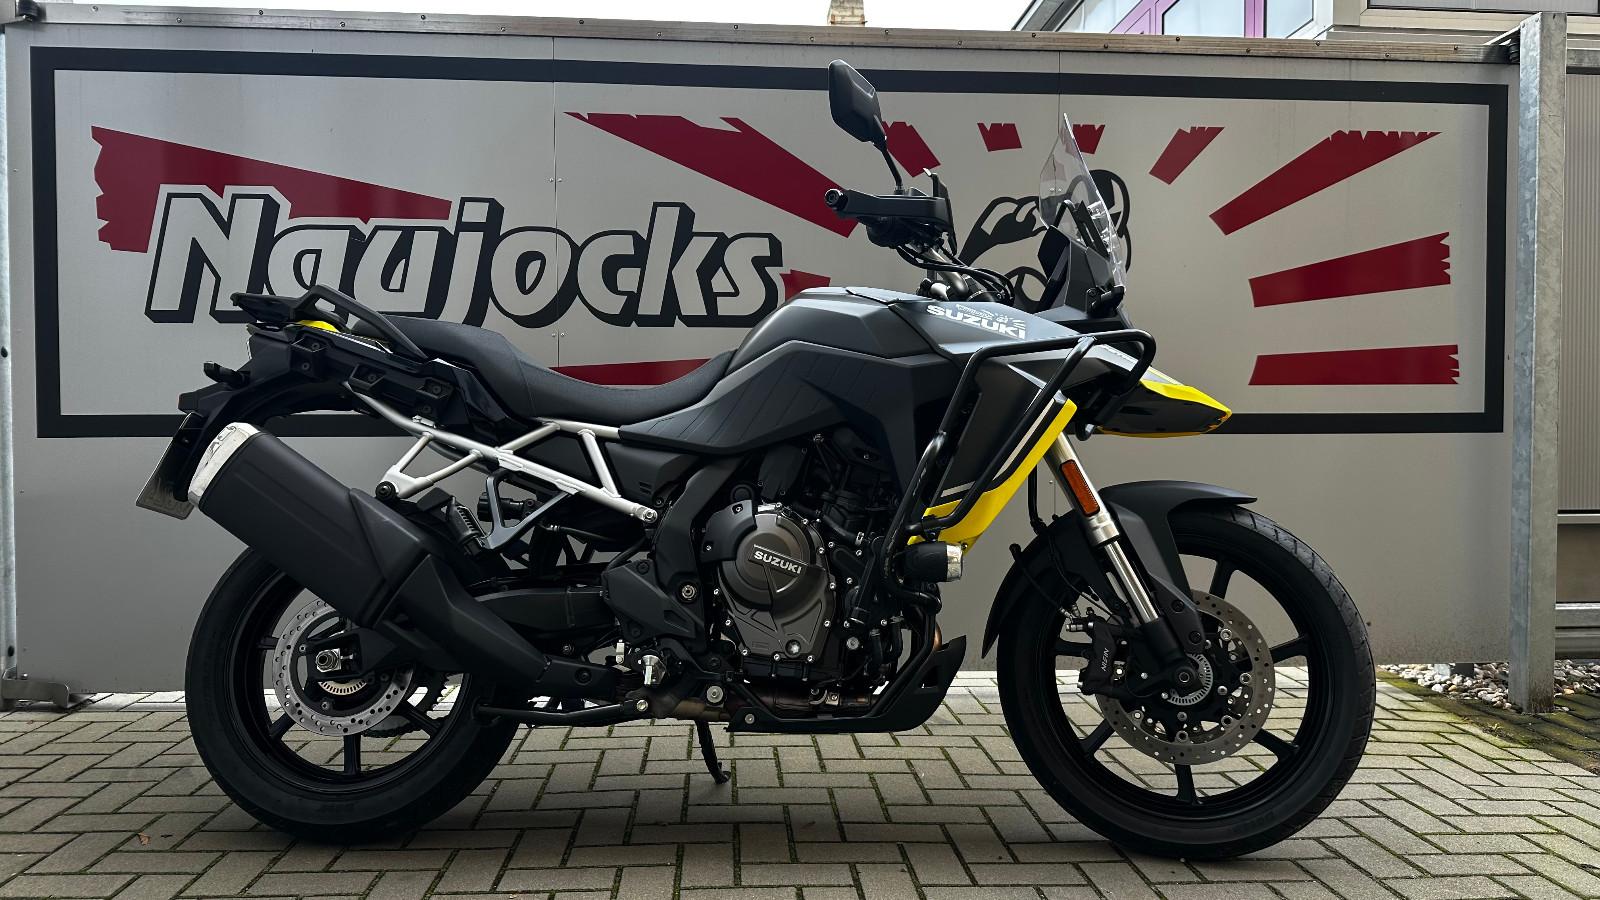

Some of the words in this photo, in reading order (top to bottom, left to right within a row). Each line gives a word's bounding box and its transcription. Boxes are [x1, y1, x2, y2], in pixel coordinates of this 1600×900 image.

[144, 193, 783, 328] Naujocks
[926, 304, 1026, 340] SUZUKI
[753, 550, 802, 574] SUZUKI
